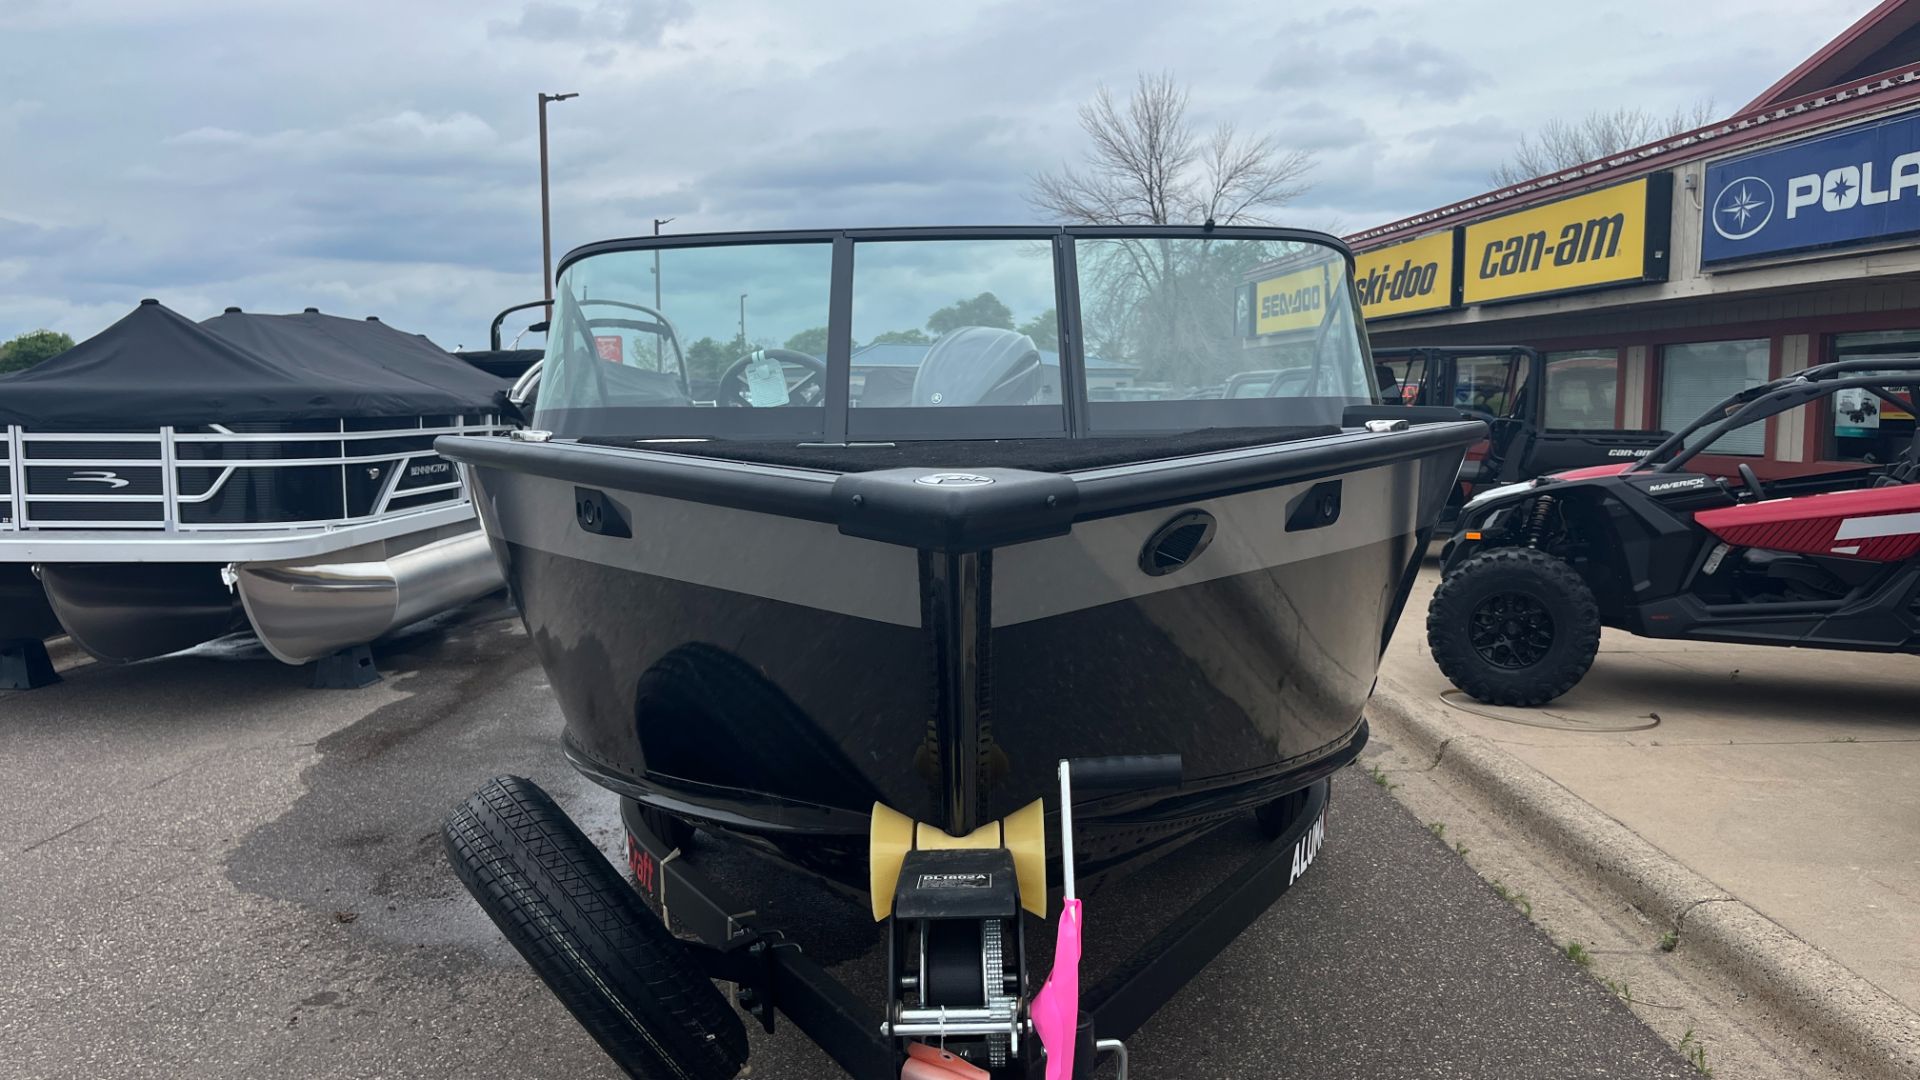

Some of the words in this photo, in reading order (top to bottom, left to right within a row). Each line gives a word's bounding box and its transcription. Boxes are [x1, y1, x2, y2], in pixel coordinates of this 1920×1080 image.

[1479, 213, 1624, 279] can-am
[1356, 260, 1438, 306] ski-doo
[1649, 478, 1704, 491] MAVERICK
